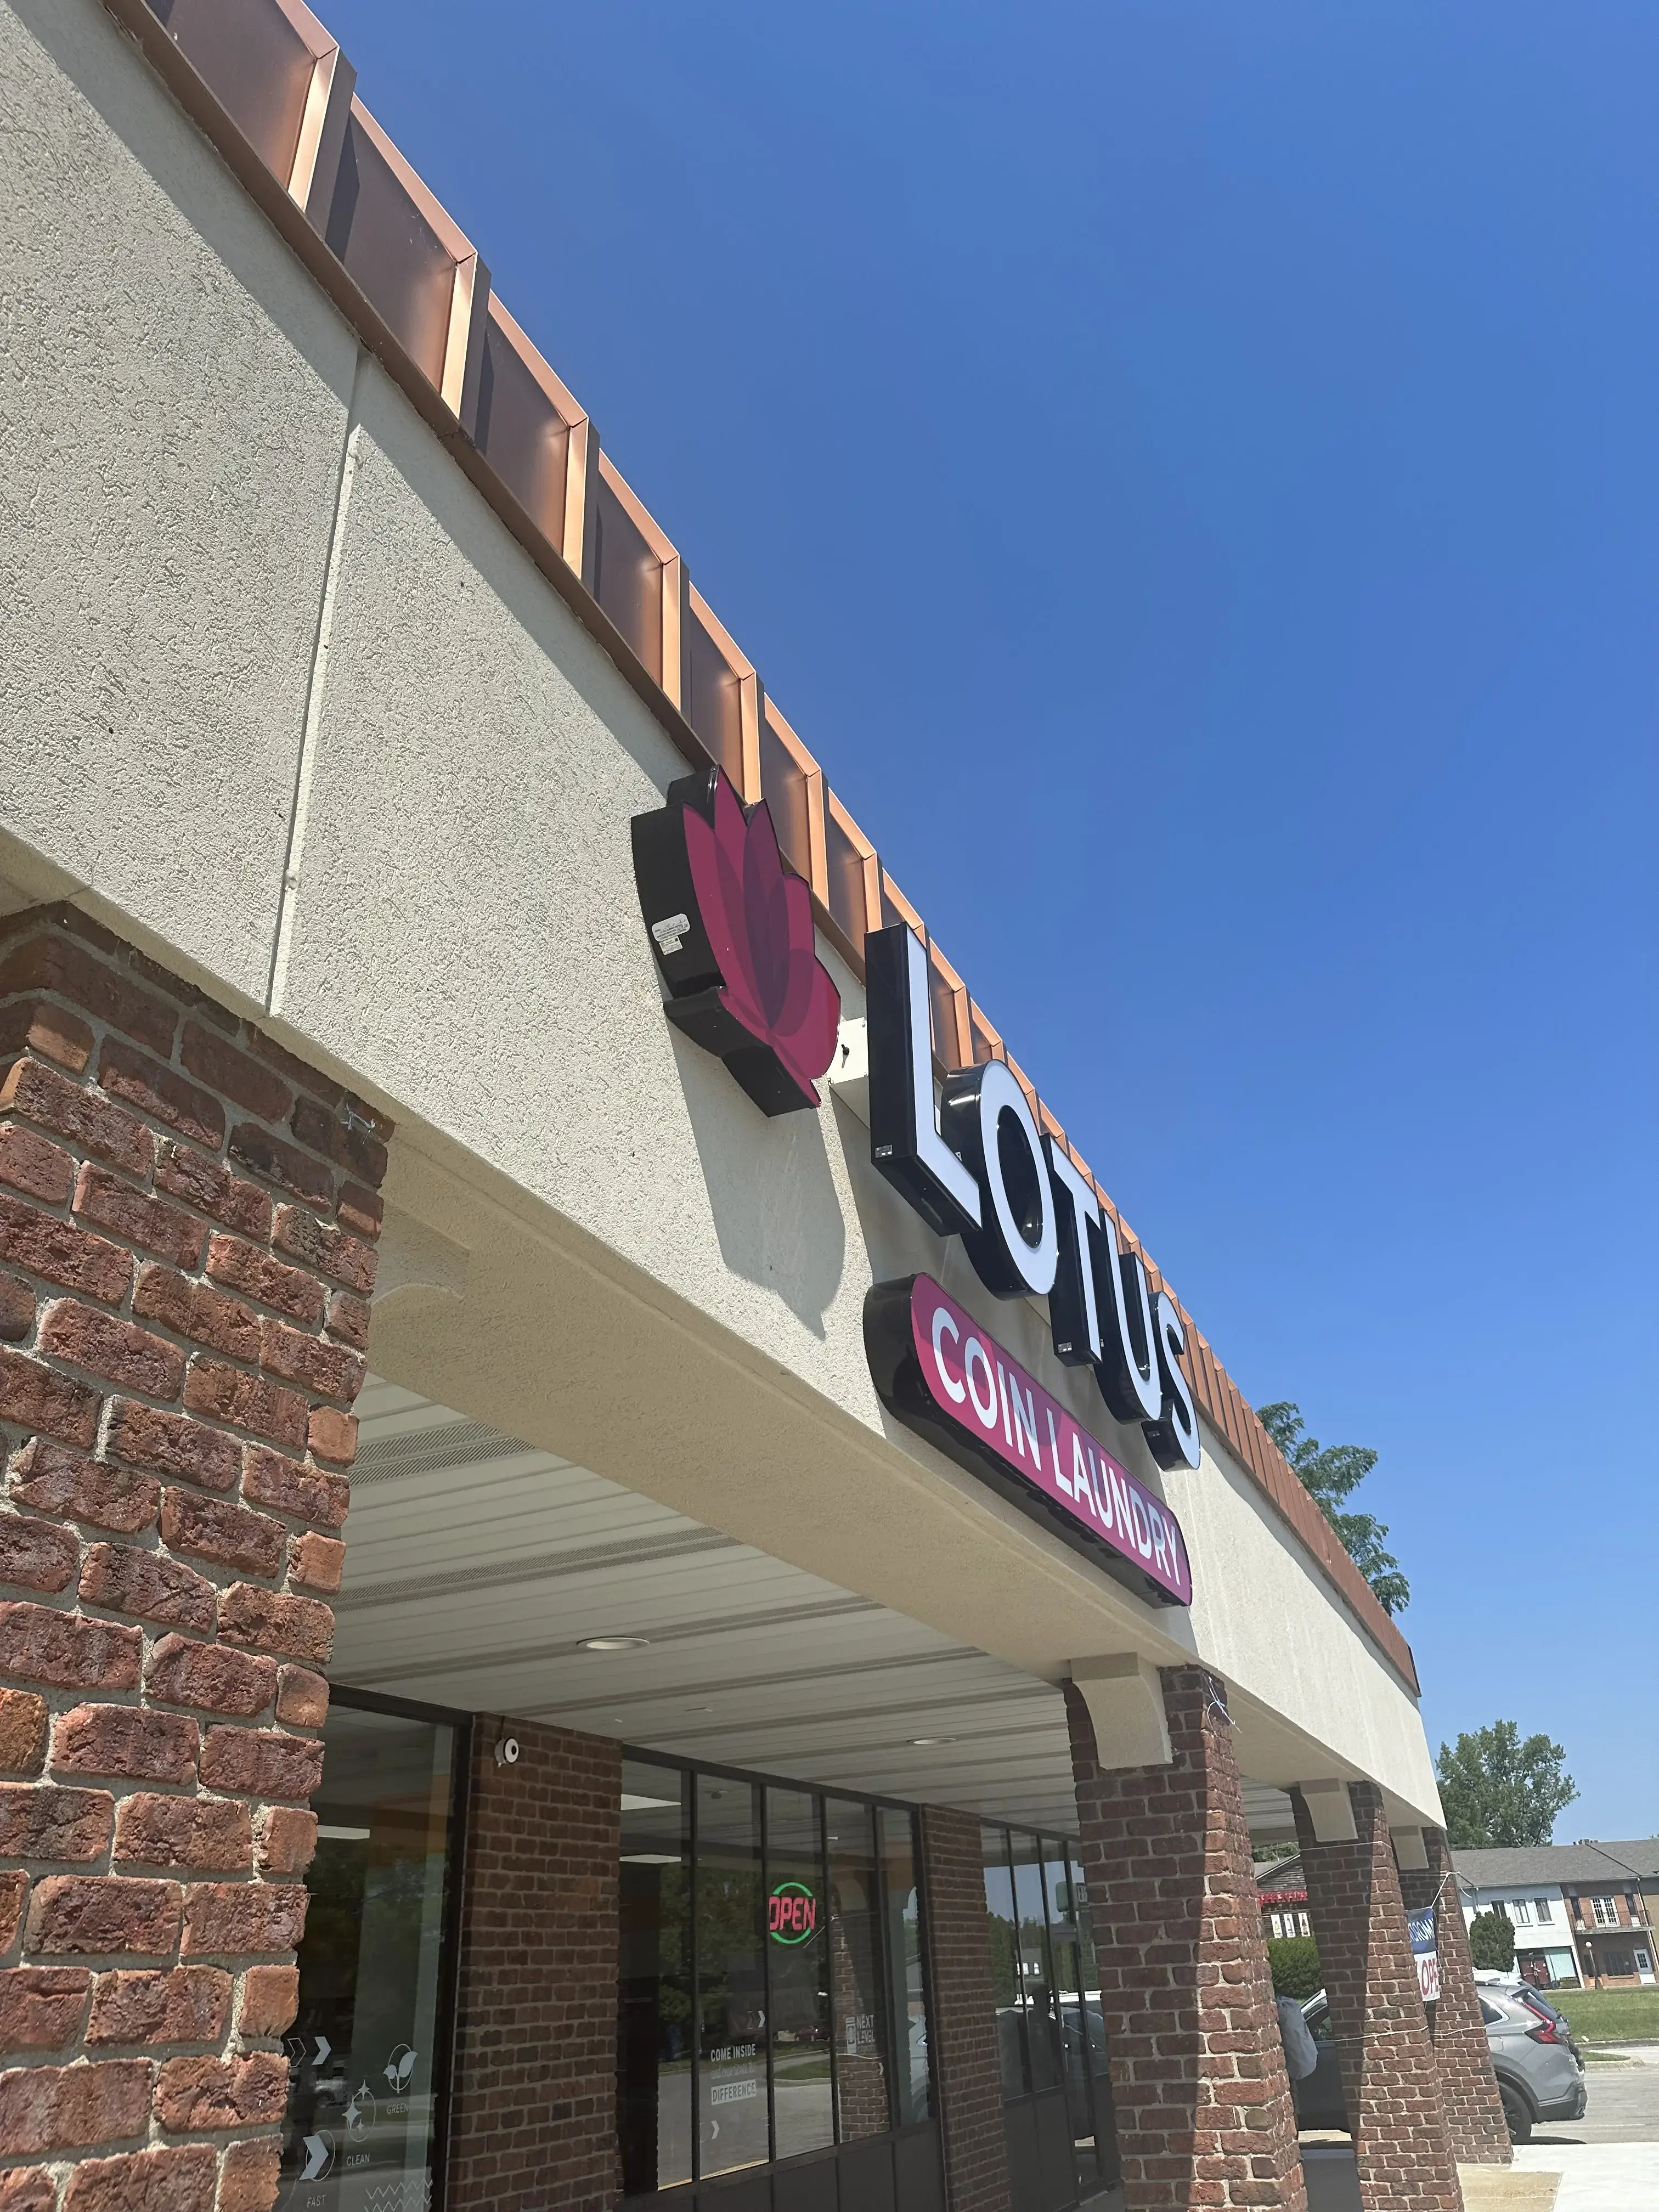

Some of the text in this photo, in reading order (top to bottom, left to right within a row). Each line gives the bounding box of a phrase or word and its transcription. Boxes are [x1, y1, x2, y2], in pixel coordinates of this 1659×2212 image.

[904, 922, 1201, 1470] LOTUS
[932, 1306, 1181, 1586] COIN LAUNDRY
[769, 1896, 816, 1930] OPEN
[1421, 1957, 1439, 1995] OPE
[856, 2014, 874, 2029] NEXT
[857, 2029, 875, 2045] LEVEL
[710, 2044, 756, 2062] COME INSIDE
[712, 2082, 756, 2102] DIFFERENCE
[387, 2103, 409, 2115] GREEN
[346, 2152, 371, 2166] CLEAN
[306, 2194, 327, 2208] FAST
